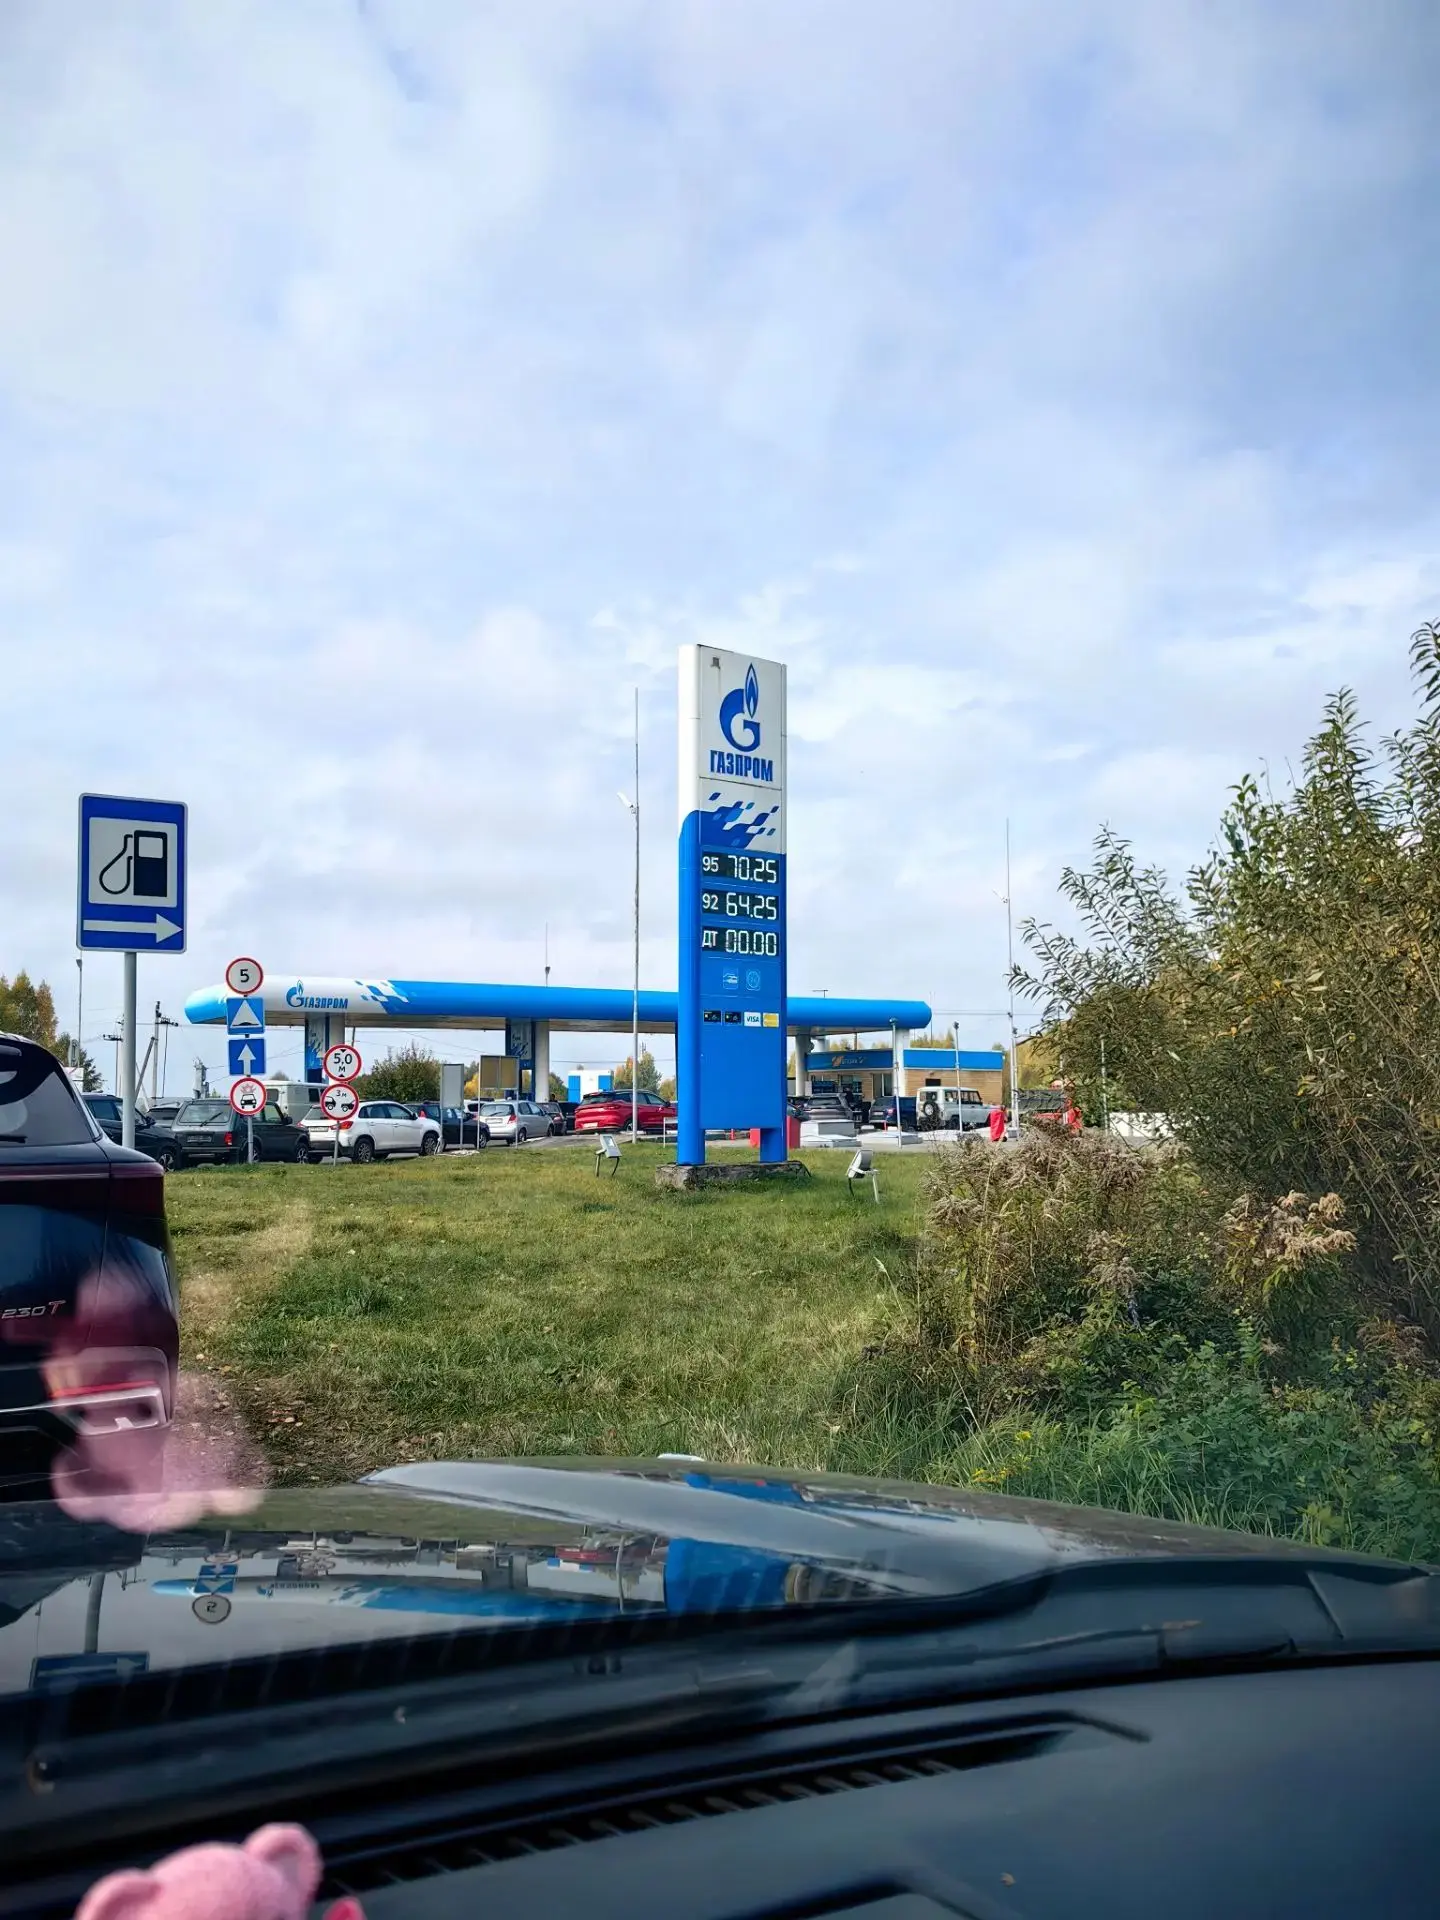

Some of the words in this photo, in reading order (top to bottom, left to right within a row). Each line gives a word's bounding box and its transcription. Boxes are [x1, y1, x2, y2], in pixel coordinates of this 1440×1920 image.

[709, 750, 773, 782] ГАЗПРОМ
[702, 856, 719, 873] 95
[727, 855, 777, 884] 70.25
[702, 893, 719, 911] 92
[726, 892, 777, 920] 64.25
[701, 929, 719, 948] ДТ
[725, 929, 777, 956] 00.00
[240, 968, 250, 983] 5
[304, 997, 349, 1009] ГАЗПРОМ
[333, 1053, 353, 1066] 5,0
[1, 1300, 67, 1319] 230T
